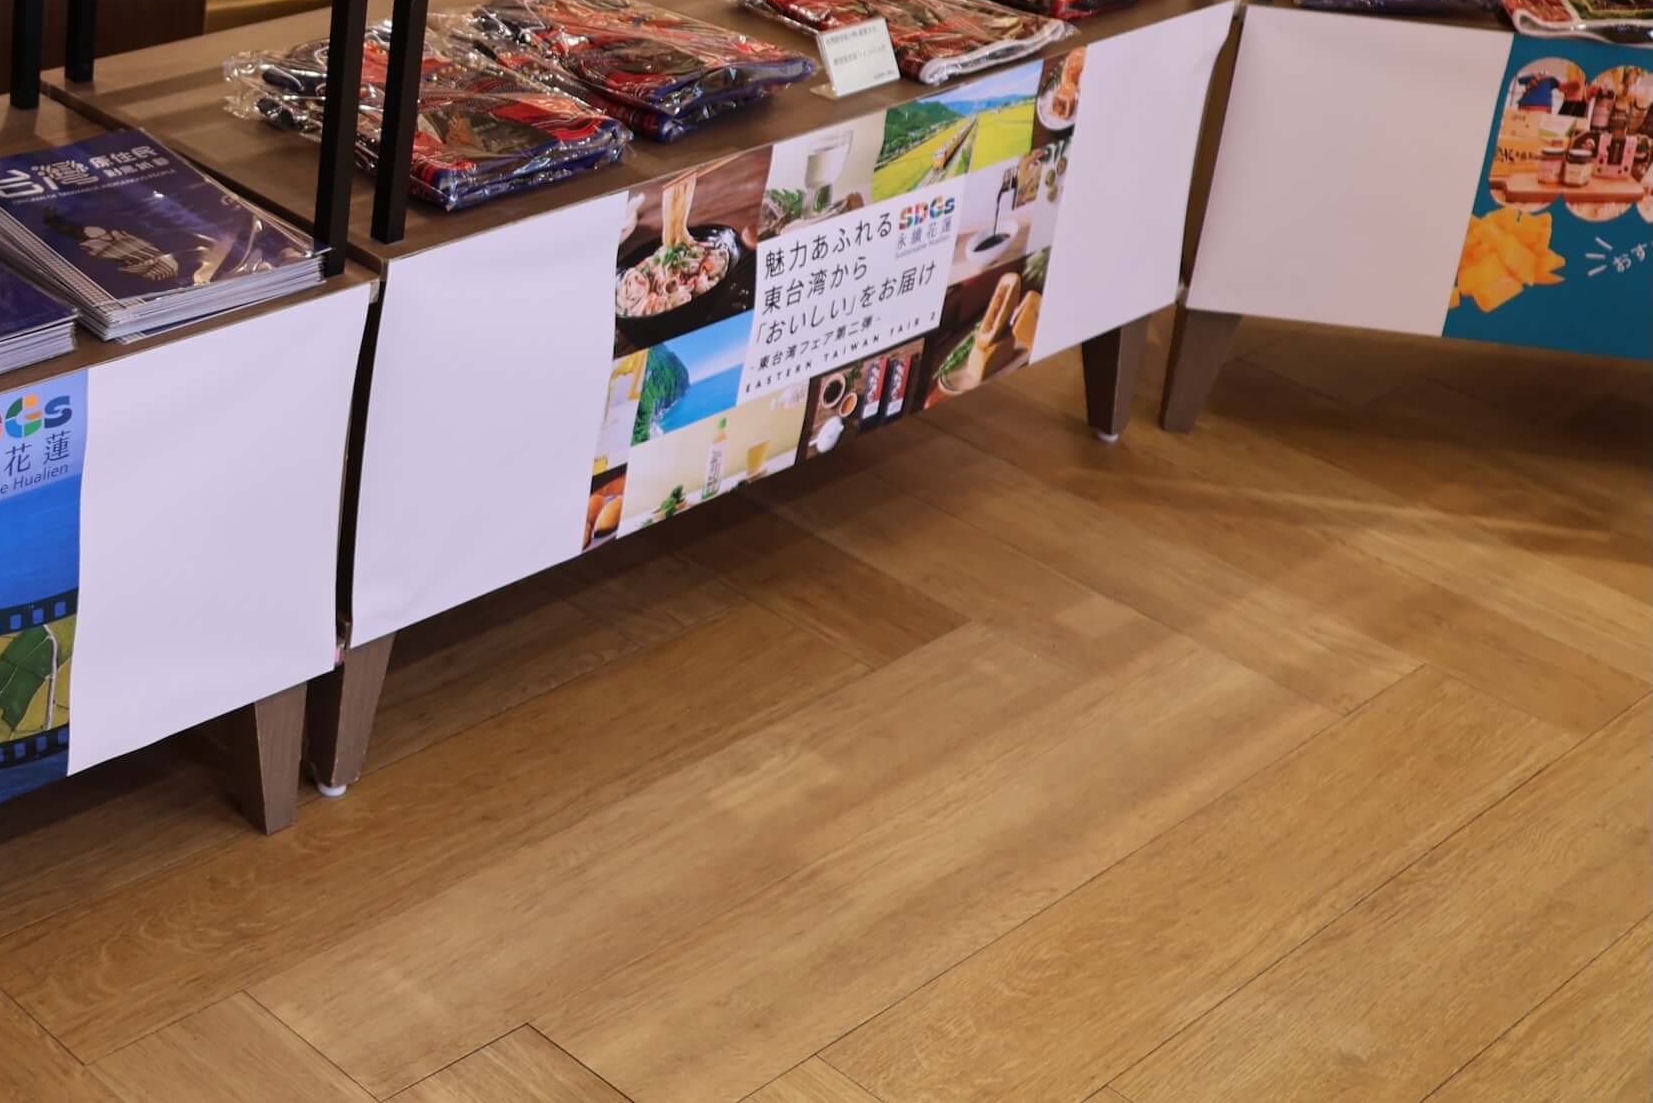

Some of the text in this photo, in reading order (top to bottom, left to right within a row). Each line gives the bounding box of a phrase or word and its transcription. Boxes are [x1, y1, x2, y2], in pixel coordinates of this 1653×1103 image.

[899, 194, 955, 230] SDGs
[765, 212, 893, 280] 魅力あふれる
[1612, 242, 1653, 273] おす
[756, 260, 937, 345] 「おいしい」をお届け
[762, 255, 868, 316] 東台湾から
[745, 310, 937, 394] EASTERN TAIWAN FAIR 2
[12, 463, 70, 491] Hualien
